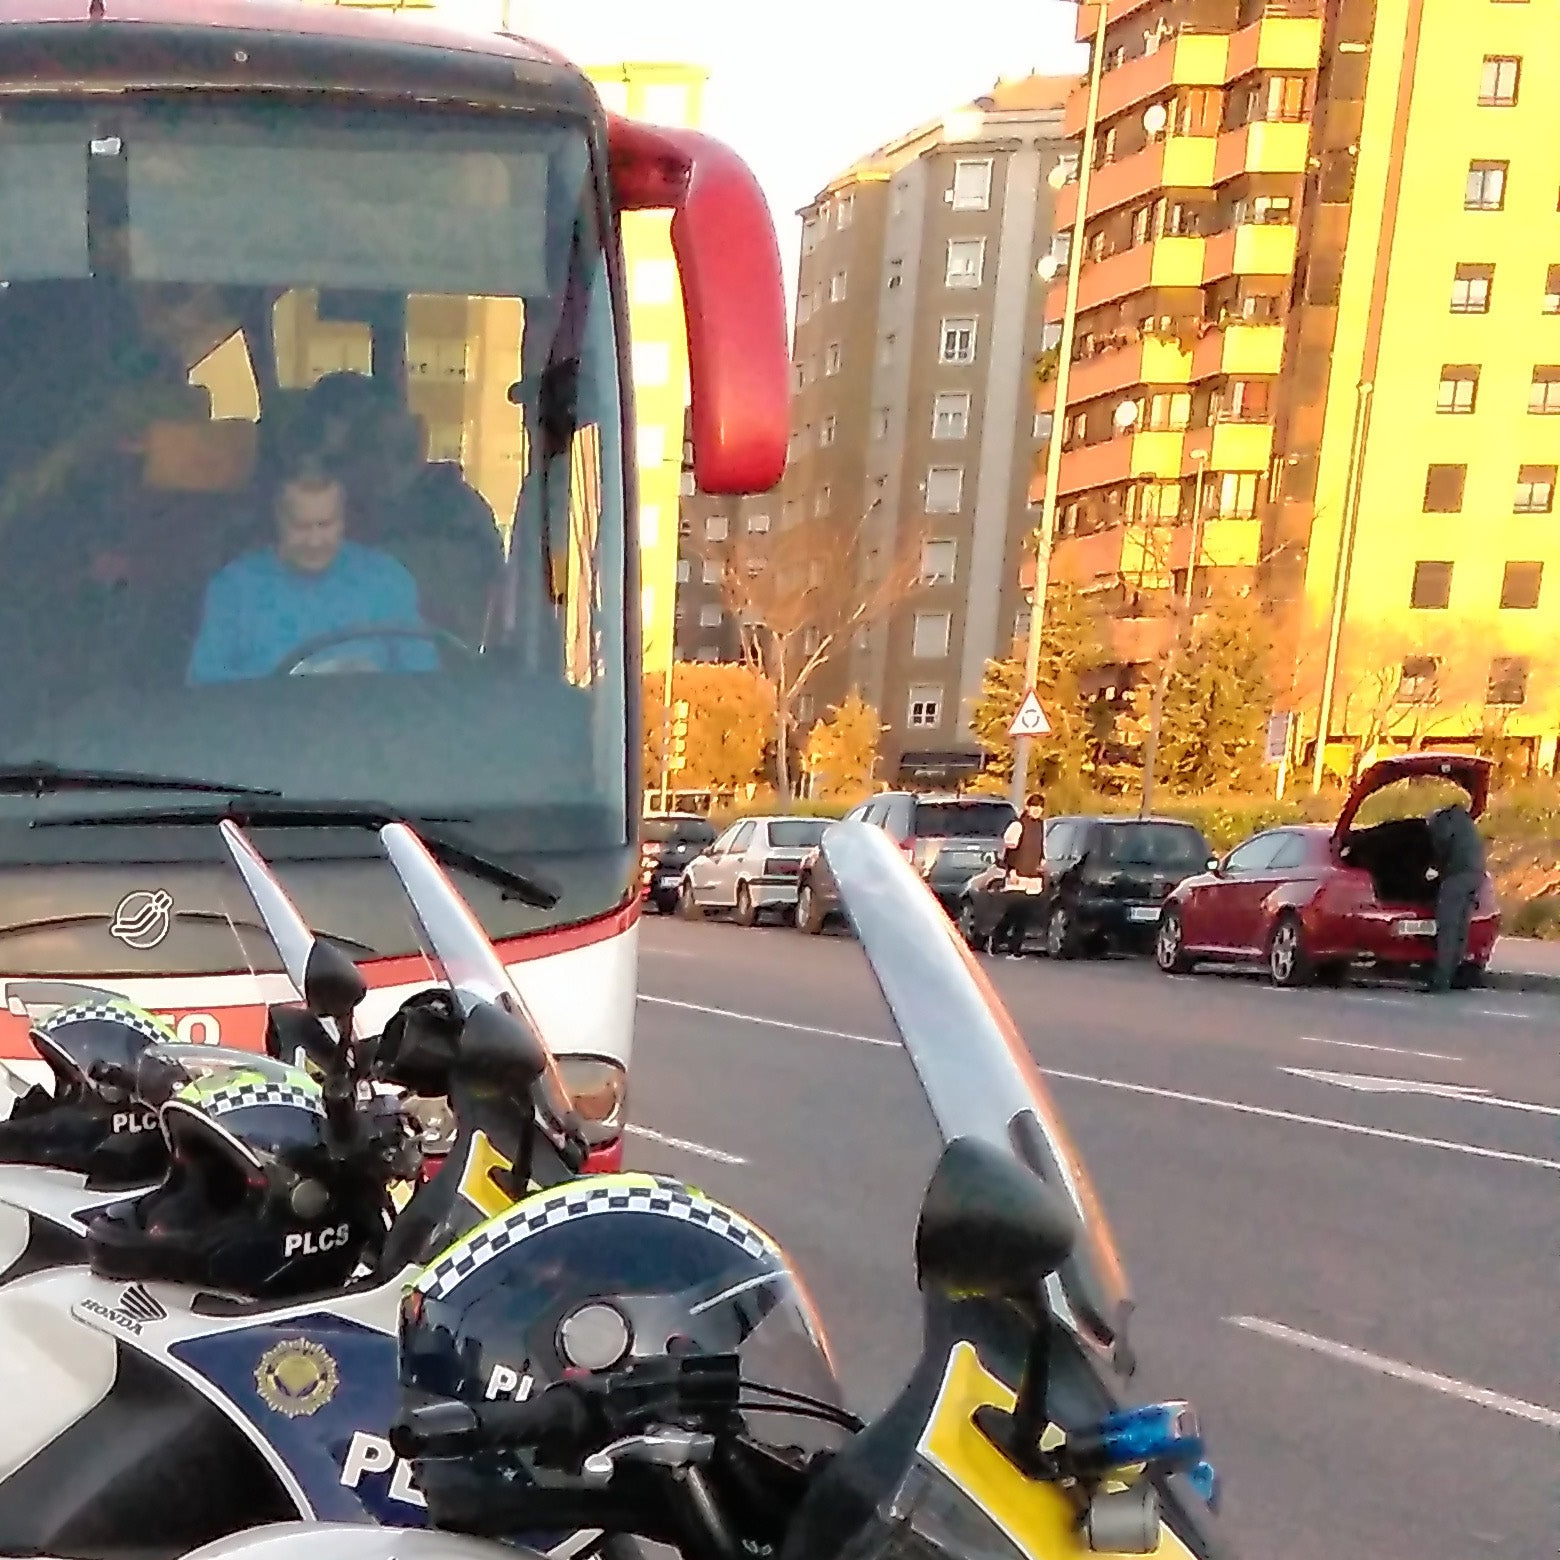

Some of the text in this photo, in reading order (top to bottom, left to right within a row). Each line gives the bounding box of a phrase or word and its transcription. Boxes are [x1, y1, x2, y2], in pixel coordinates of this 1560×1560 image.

[112, 1111, 160, 1134] PLC
[284, 1222, 350, 1257] PLCS
[80, 1298, 143, 1336] HONDA
[339, 1430, 429, 1508] PL
